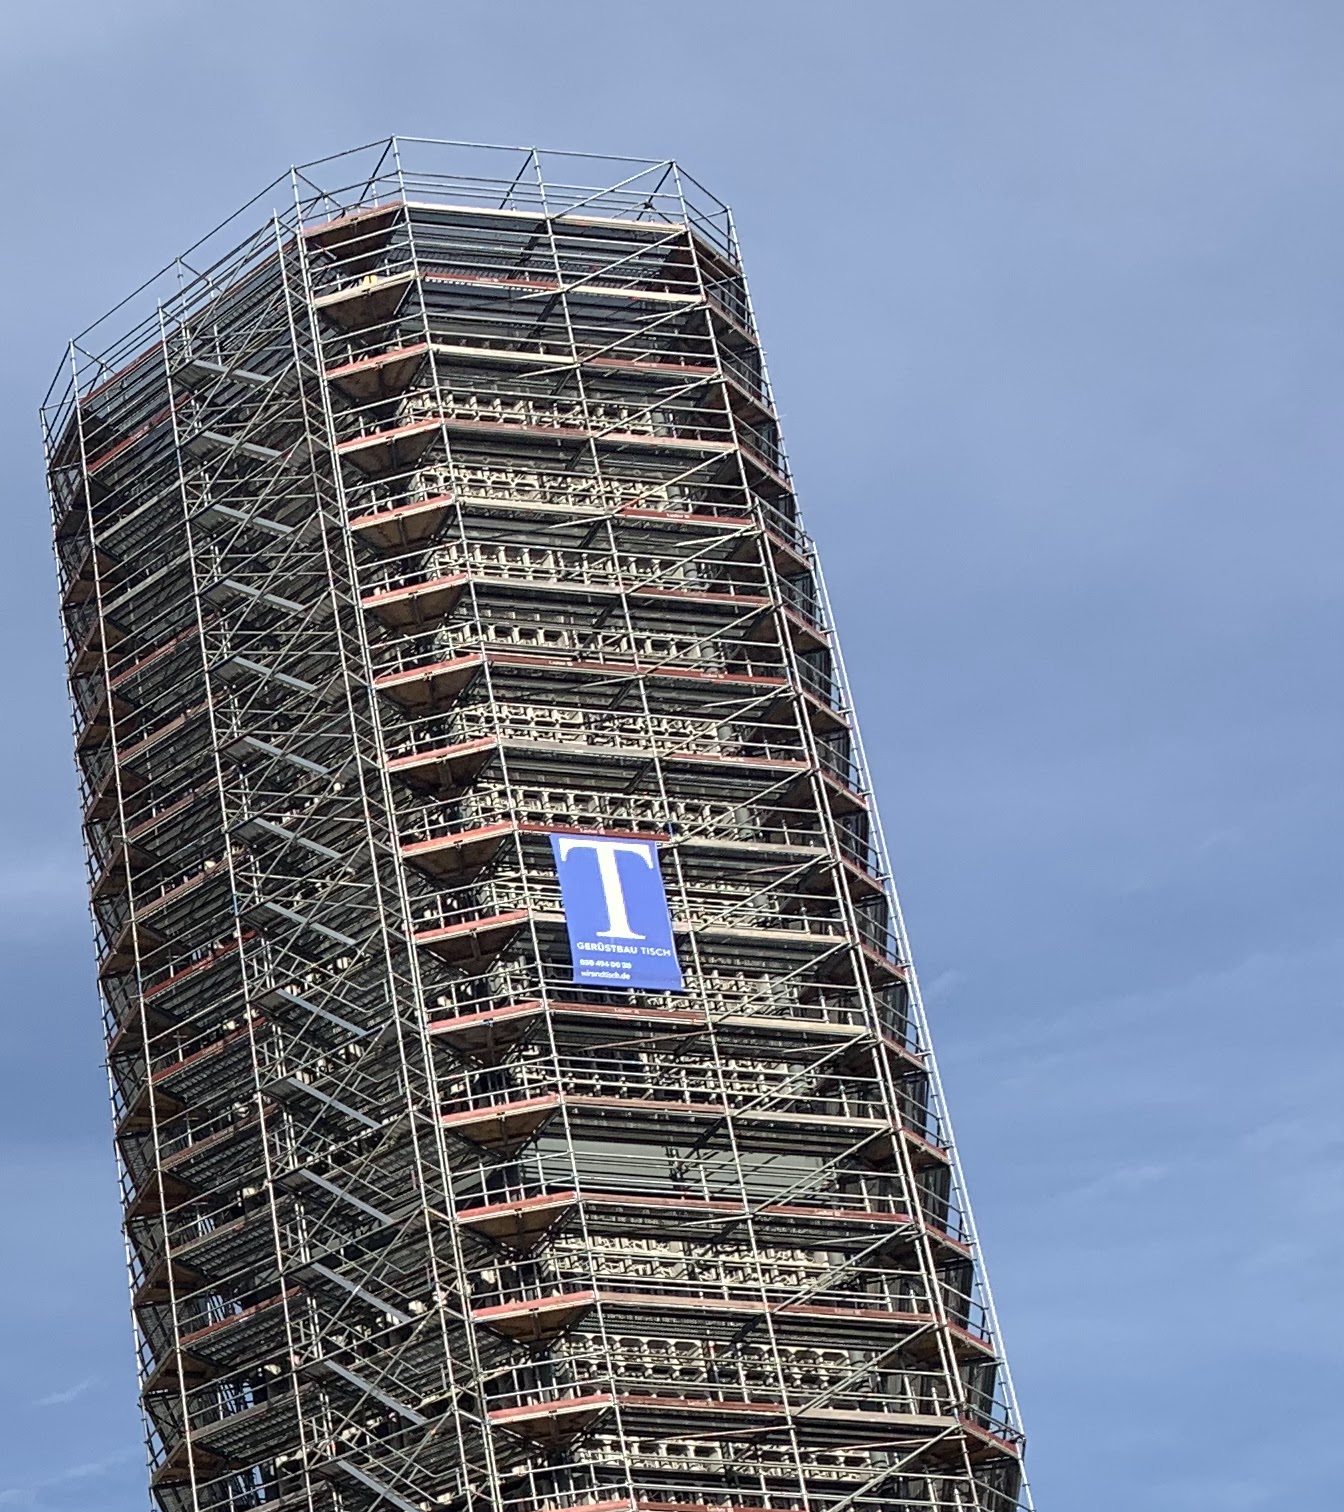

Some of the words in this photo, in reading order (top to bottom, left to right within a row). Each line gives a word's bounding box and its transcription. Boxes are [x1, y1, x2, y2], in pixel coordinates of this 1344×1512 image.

[558, 837, 654, 940] T
[577, 942, 638, 954] GERÜSTBAU
[640, 946, 672, 957] TISCH
